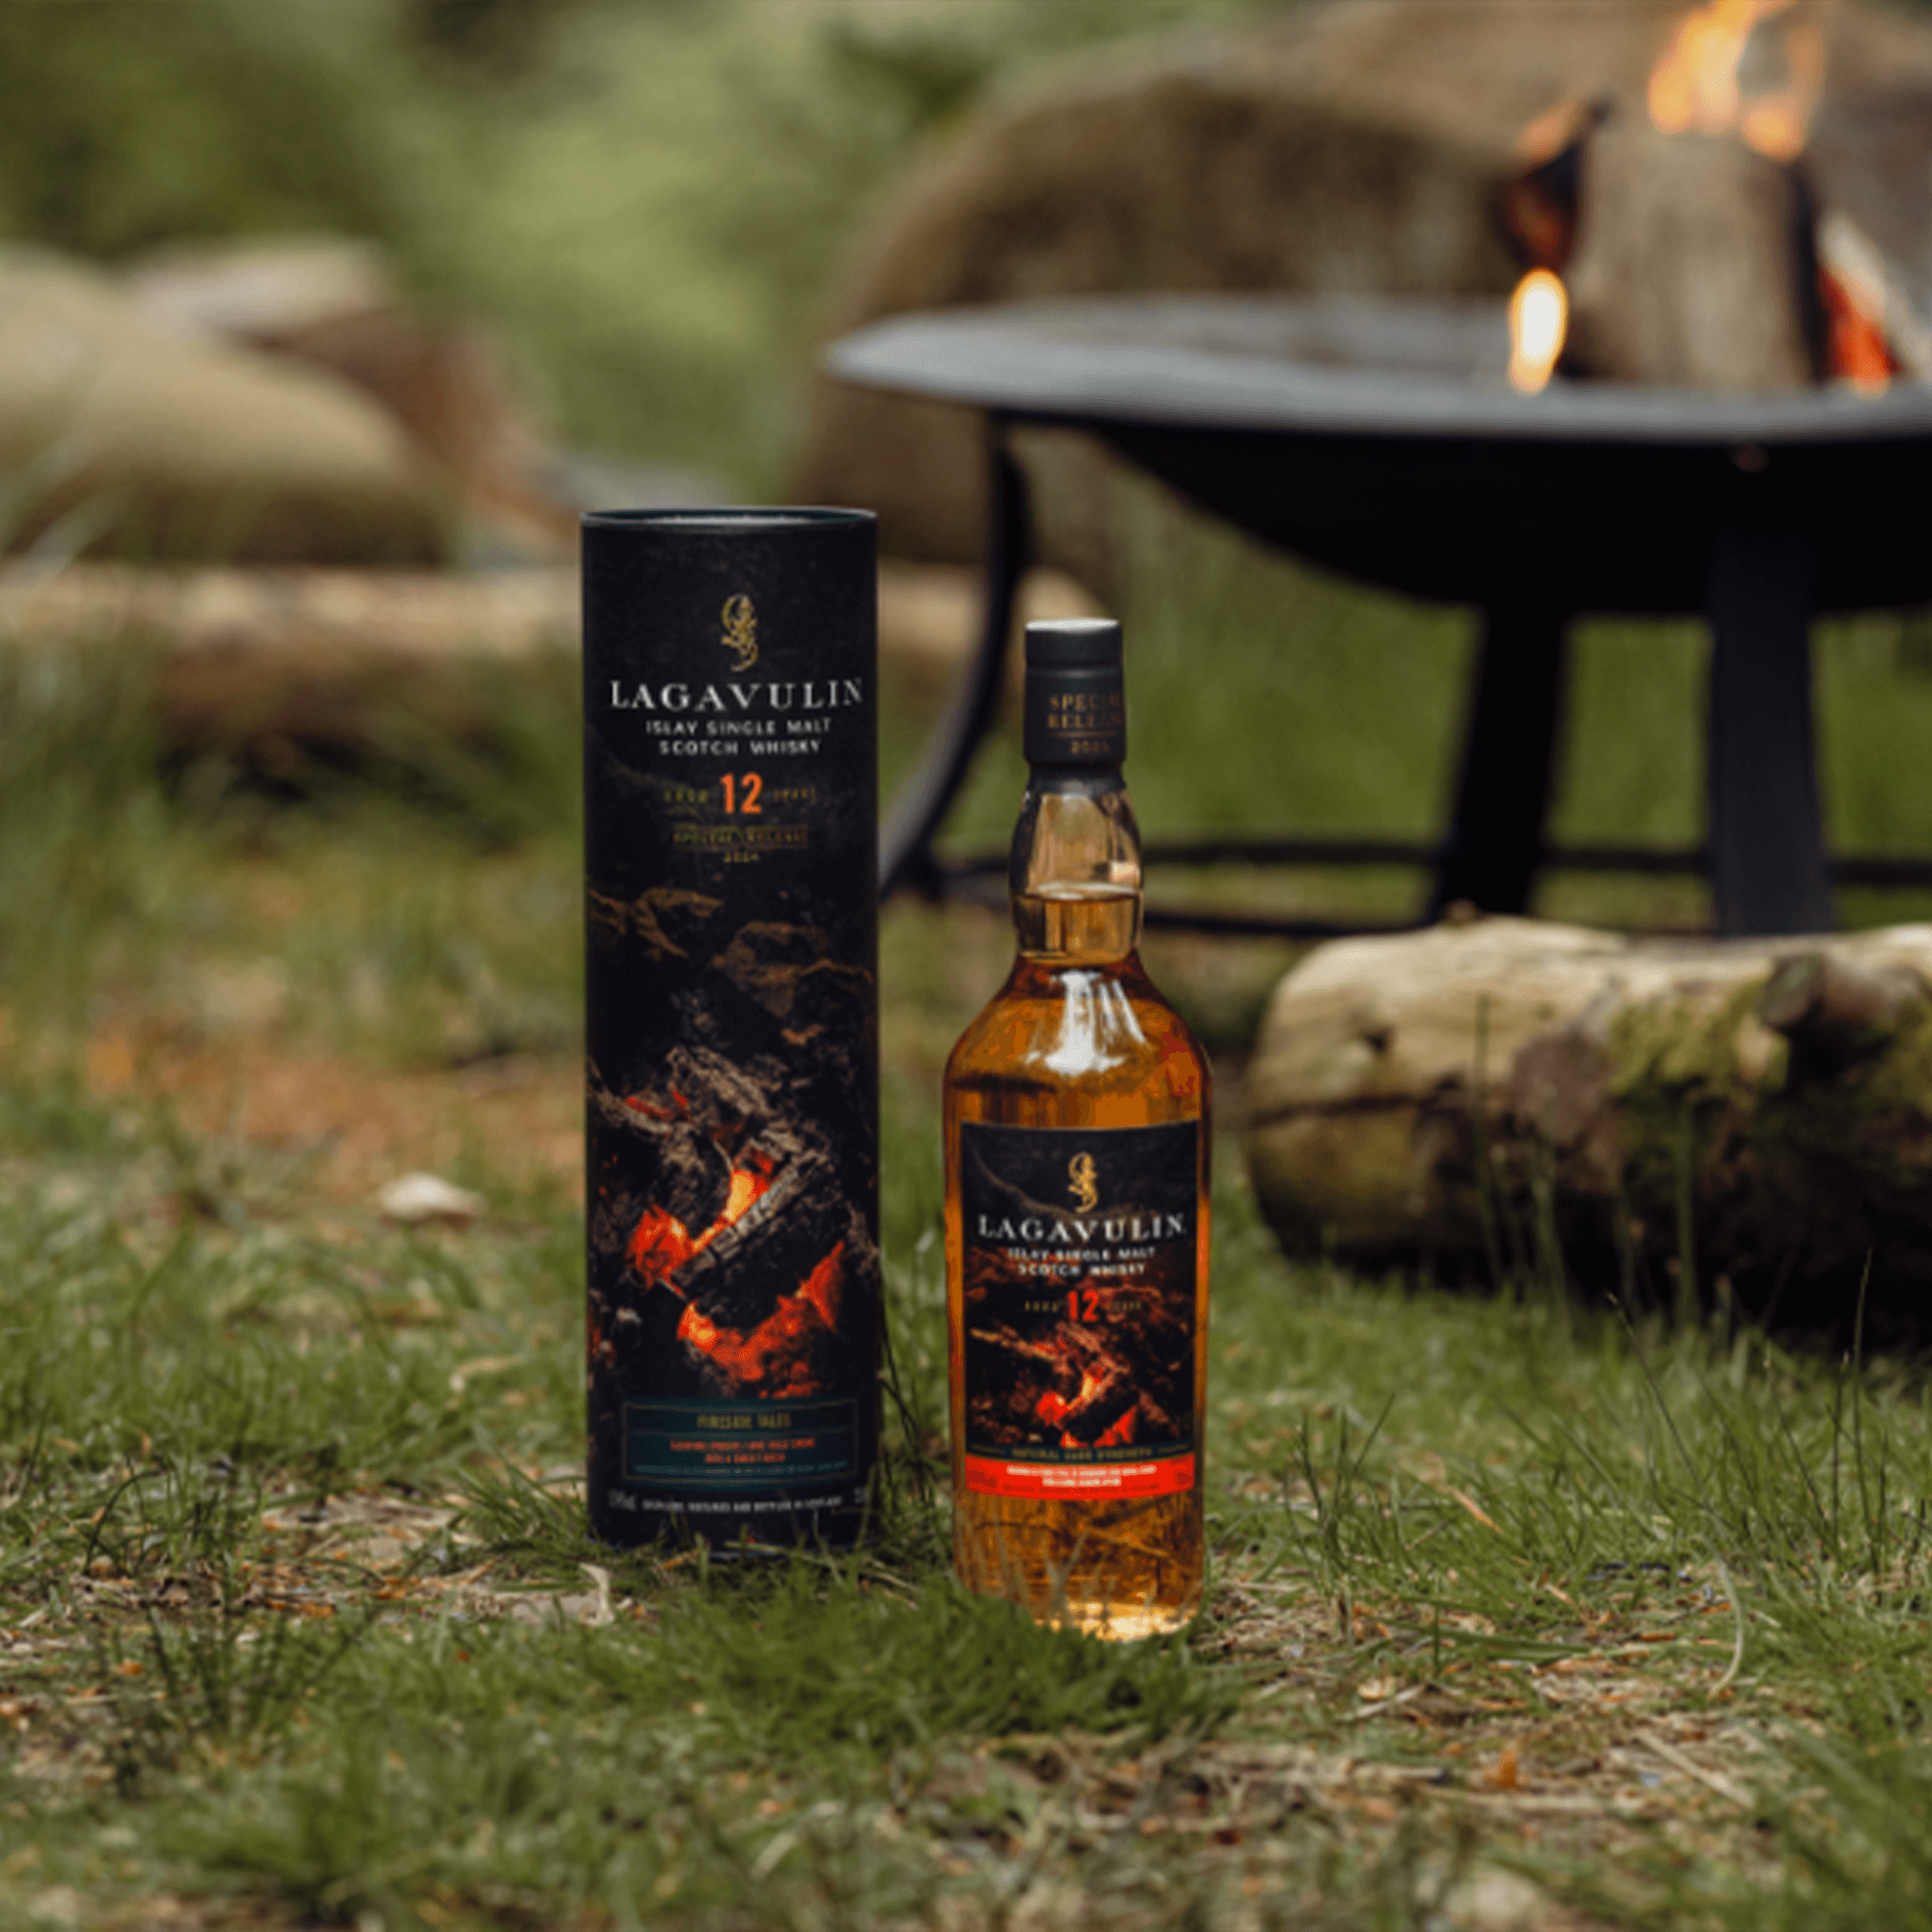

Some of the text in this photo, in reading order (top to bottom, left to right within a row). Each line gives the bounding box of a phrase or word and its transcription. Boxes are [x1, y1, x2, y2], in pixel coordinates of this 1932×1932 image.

[610, 678, 863, 711] LAGAVULIN
[645, 717, 832, 737] ISLAY SINGLE MALT
[659, 740, 821, 755] SCOTCH WHISKY
[721, 772, 763, 813] 12
[979, 1214, 1186, 1241] LAGAVULIN
[1017, 1263, 1081, 1277] SCOTCH
[1067, 1290, 1099, 1322] 12
